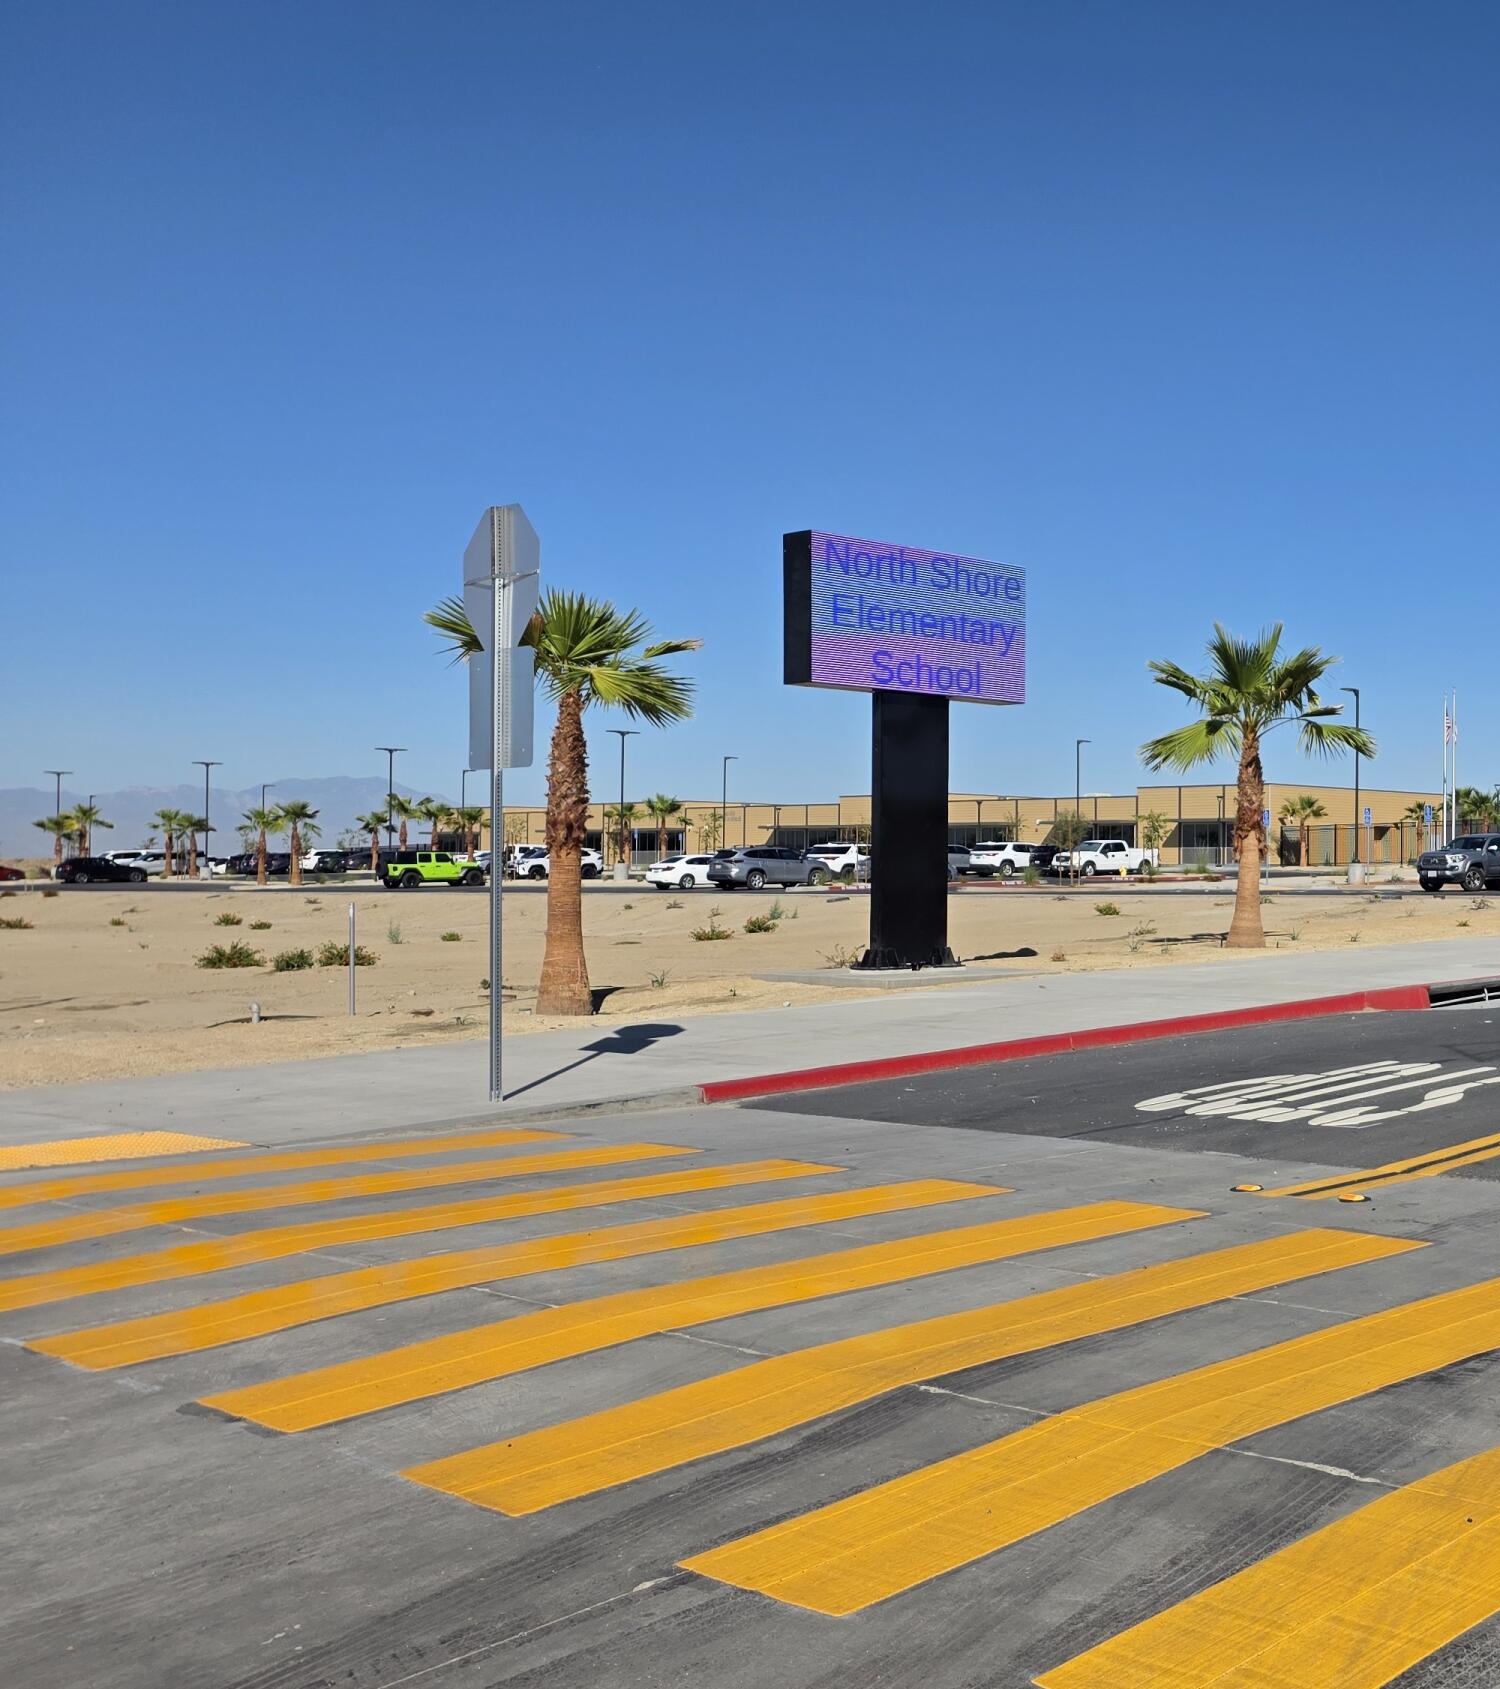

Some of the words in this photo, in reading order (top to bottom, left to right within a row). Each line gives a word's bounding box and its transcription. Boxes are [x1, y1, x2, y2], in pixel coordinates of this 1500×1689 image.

[825, 539, 917, 585] North
[930, 557, 1022, 601] Shore
[832, 593, 1016, 657] Elementary
[870, 650, 981, 694] School
